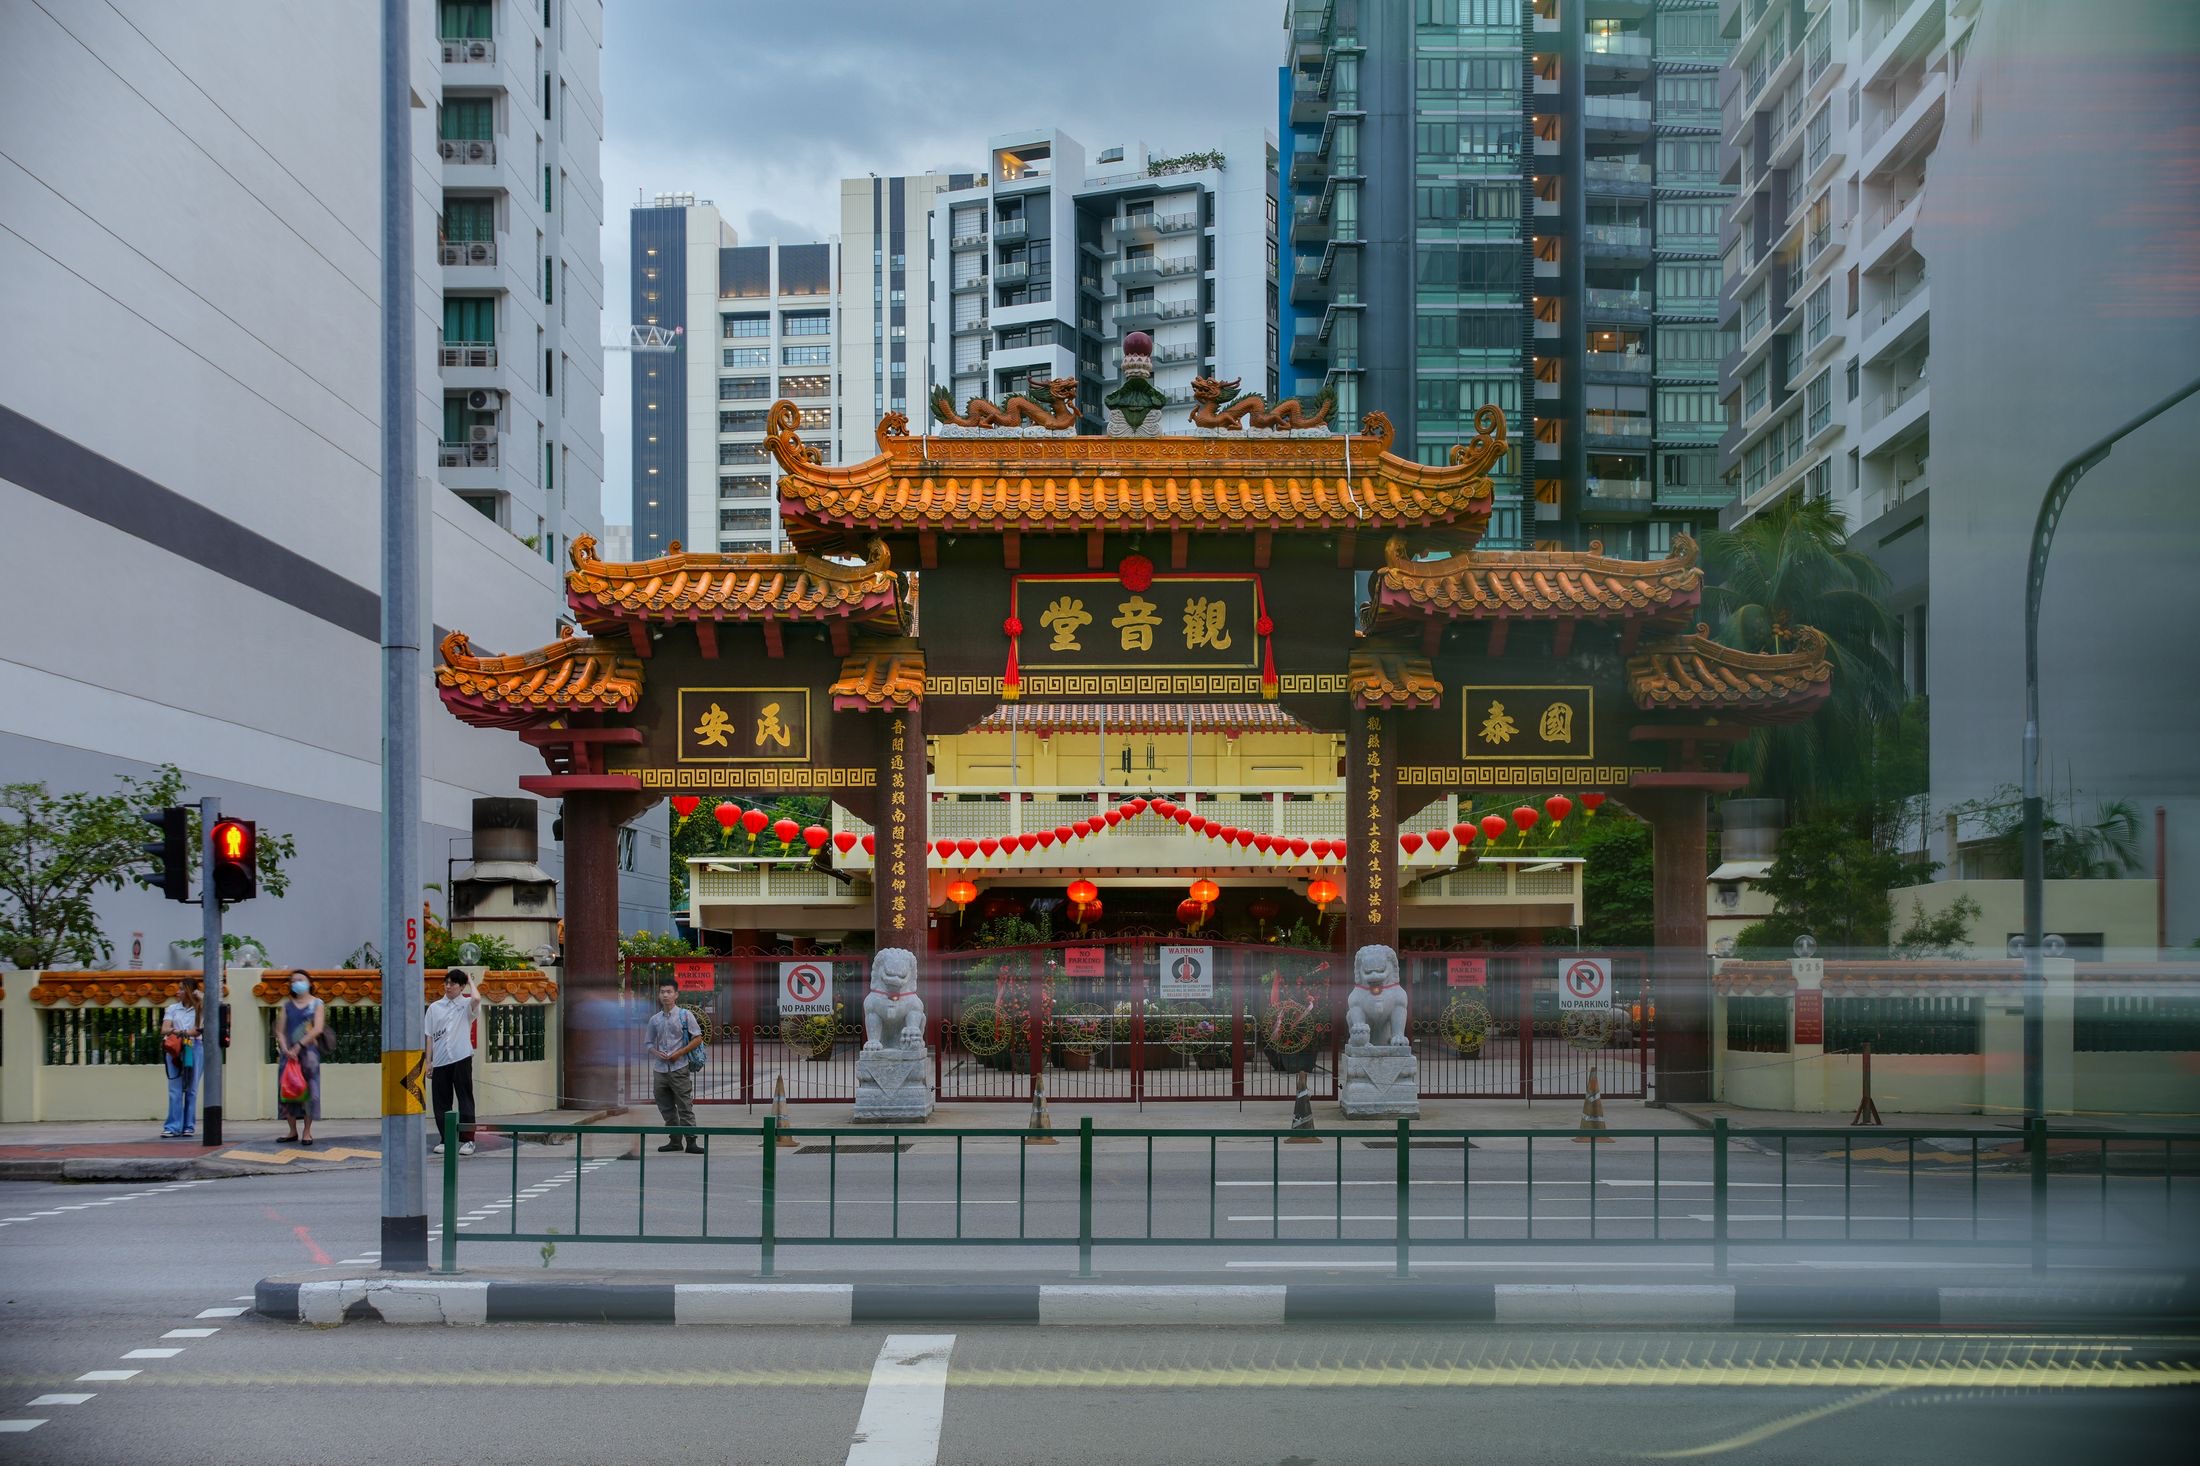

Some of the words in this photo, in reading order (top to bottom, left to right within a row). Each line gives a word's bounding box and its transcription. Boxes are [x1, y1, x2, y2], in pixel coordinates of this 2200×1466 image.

[1561, 1000, 1572, 1008] NO
[1573, 1000, 1609, 1008] PARKING
[781, 1004, 793, 1013] NO
[794, 1004, 831, 1013] PARKING
